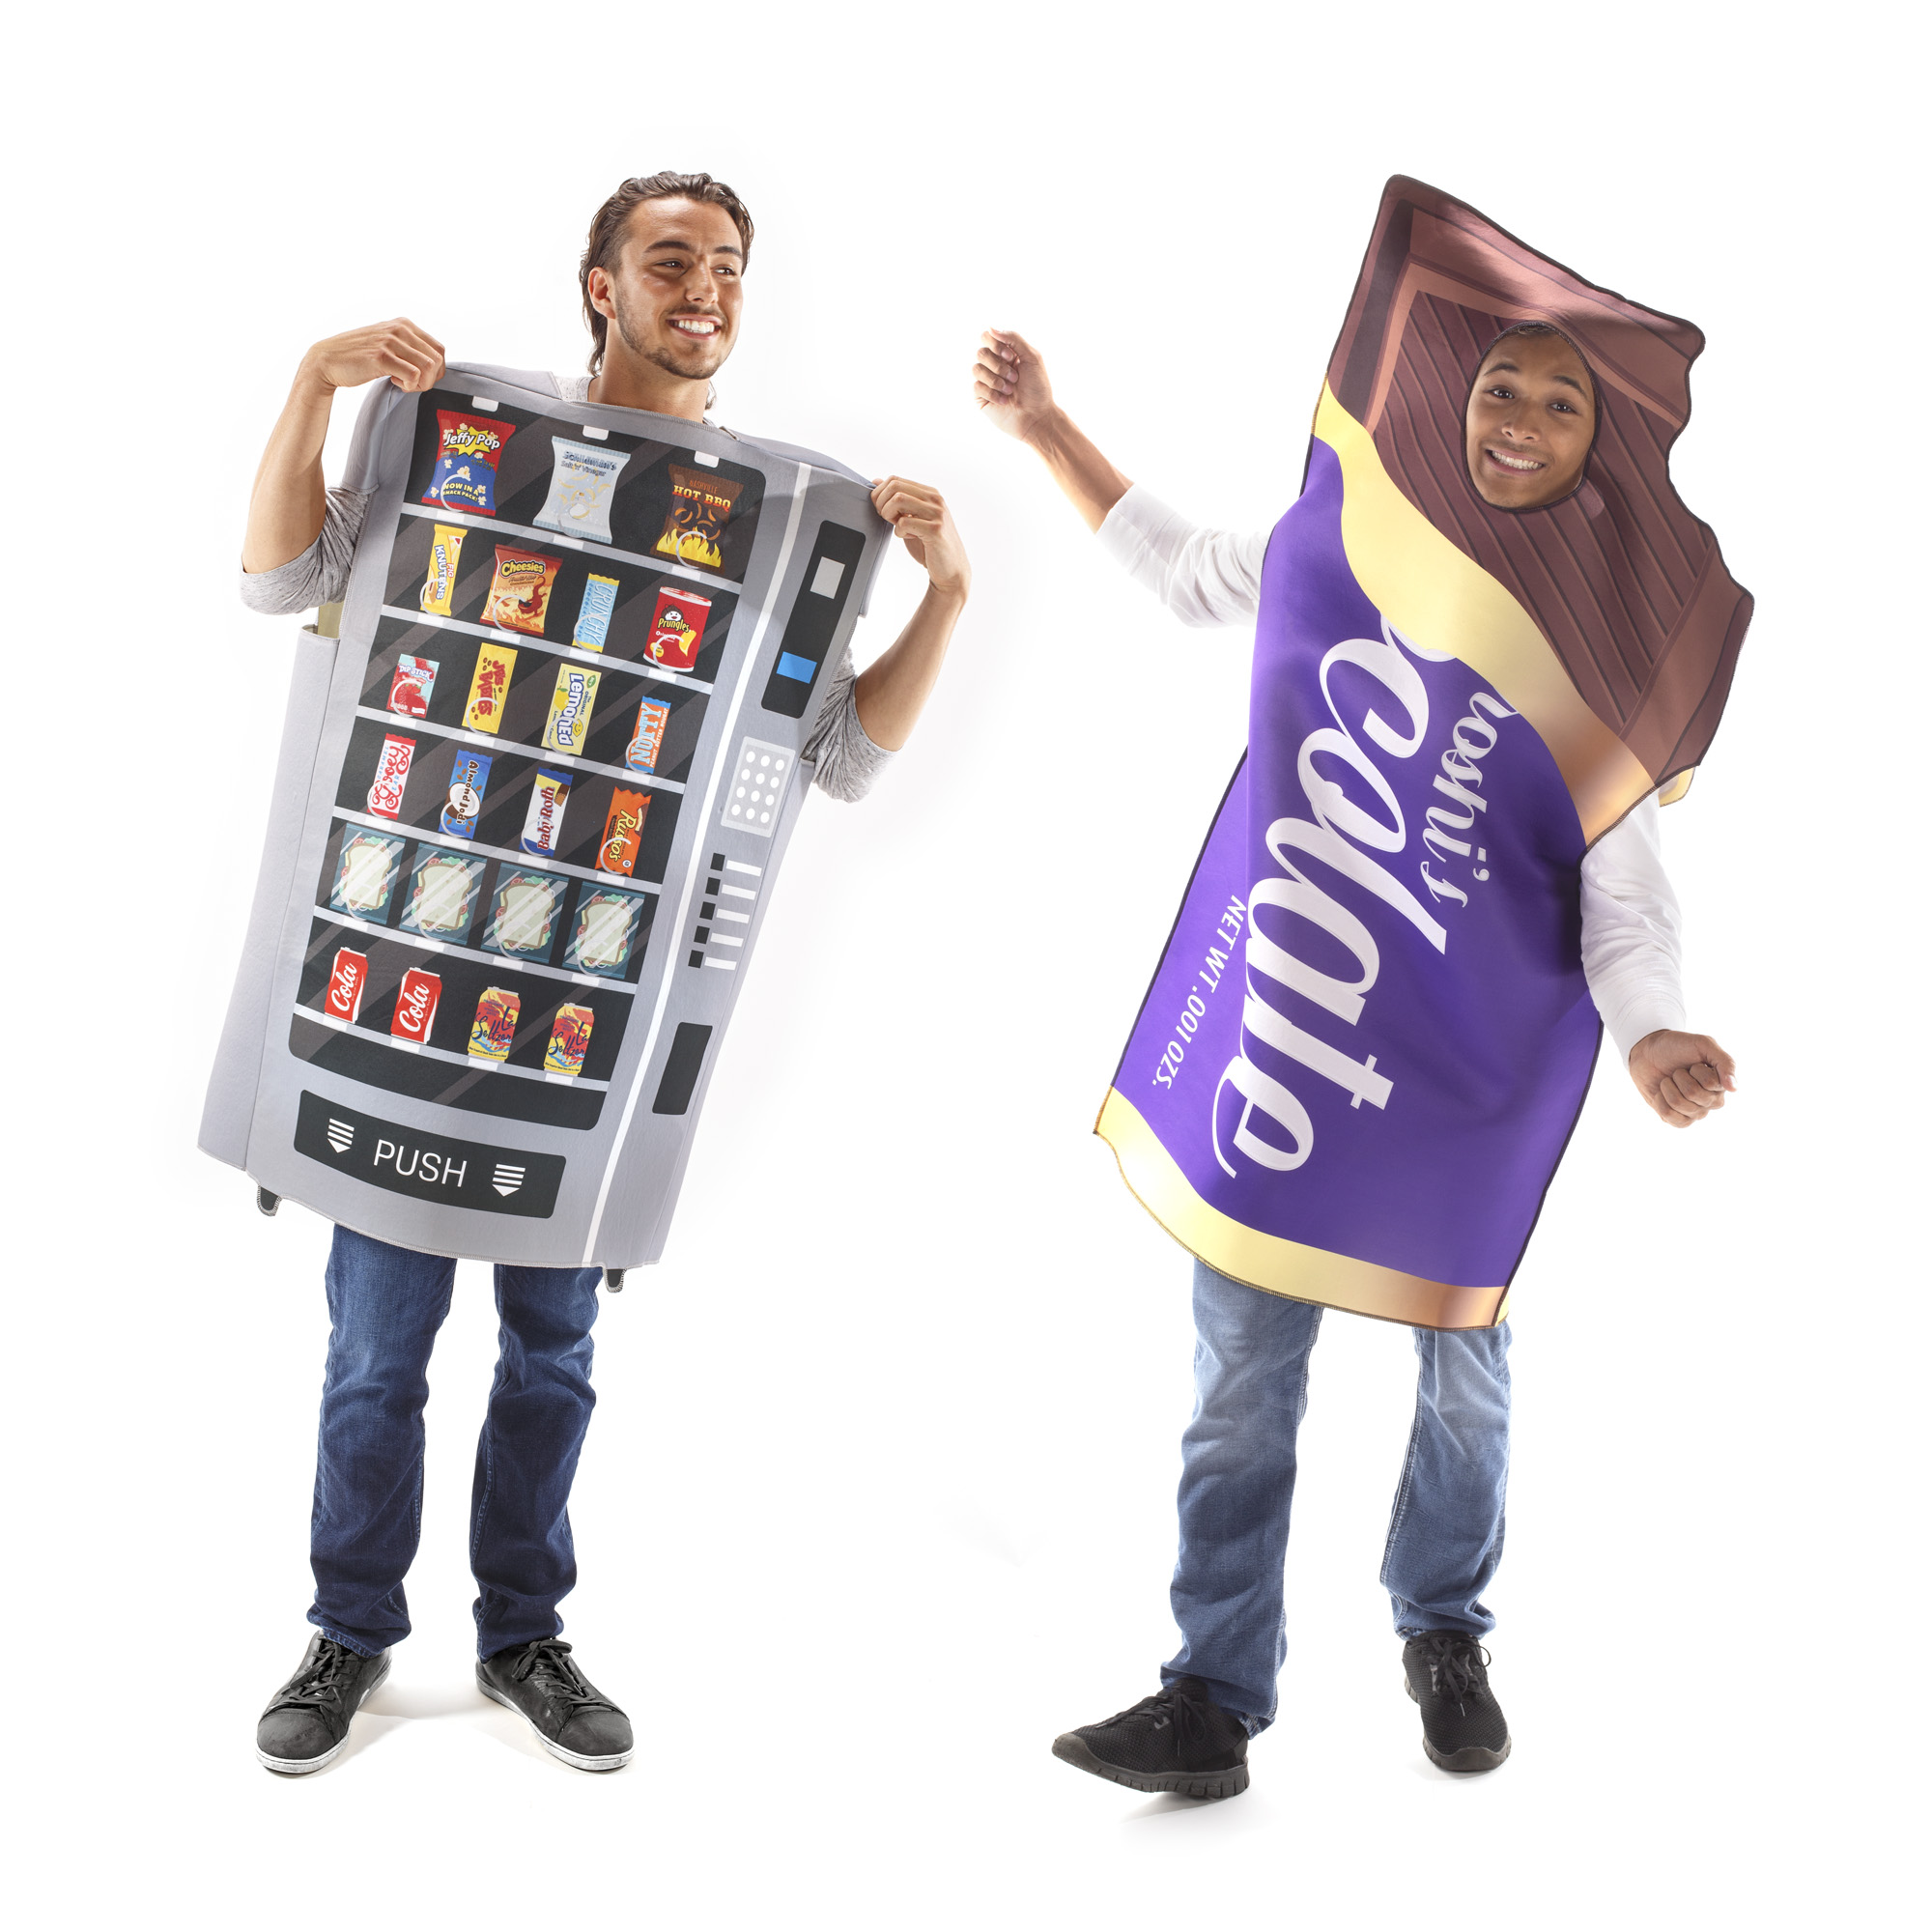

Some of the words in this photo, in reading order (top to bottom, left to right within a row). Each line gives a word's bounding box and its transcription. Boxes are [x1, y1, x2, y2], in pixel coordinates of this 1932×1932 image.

[442, 432, 475, 447] Jeffy
[476, 434, 500, 449] Pop
[464, 484, 473, 493] IN
[672, 485, 701, 501] HOT
[703, 494, 731, 513] BBQ
[690, 479, 718, 494] NASHVILLE
[501, 559, 545, 578] Cheesies
[583, 583, 614, 644] CRUNCHY
[657, 617, 690, 633] Prungles
[398, 665, 412, 673] DIP
[411, 667, 434, 683] STICK
[580, 691, 588, 716] ORIGINAL
[630, 702, 663, 764] NUTTY
[377, 746, 389, 780] CARAMEL
[649, 749, 658, 768] PEANUT
[462, 759, 480, 802] Almond
[540, 786, 555, 818] Roth
[609, 810, 638, 862] Russo's
[1217, 895, 1247, 951] NET
[330, 962, 357, 1012] Cola
[398, 983, 430, 1033] Cola
[576, 1021, 589, 1045] La
[1151, 1040, 1184, 1090] OZS.
[373, 1139, 468, 1187] PUSH
